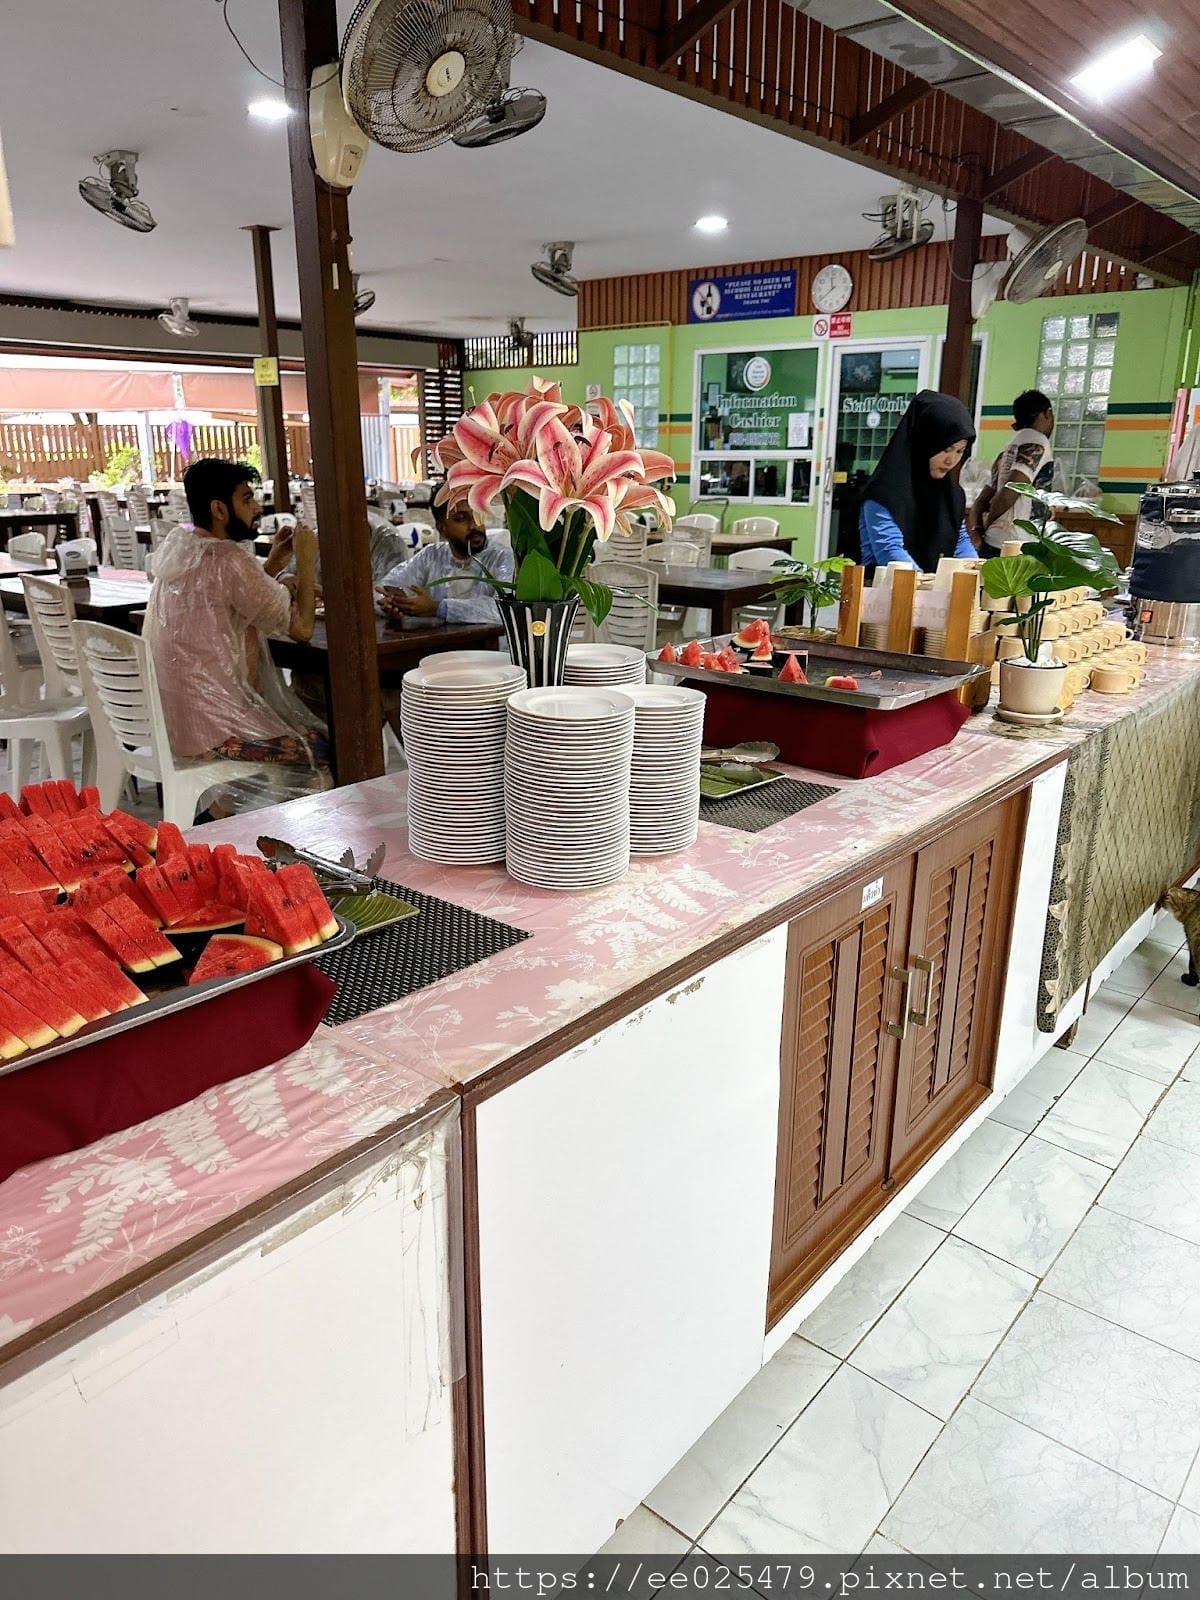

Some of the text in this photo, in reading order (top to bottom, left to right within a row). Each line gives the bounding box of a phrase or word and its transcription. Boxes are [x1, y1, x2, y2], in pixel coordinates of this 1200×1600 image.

[716, 391, 798, 409] Information
[843, 396, 912, 415] Staff Only
[729, 412, 782, 429] Cashier
